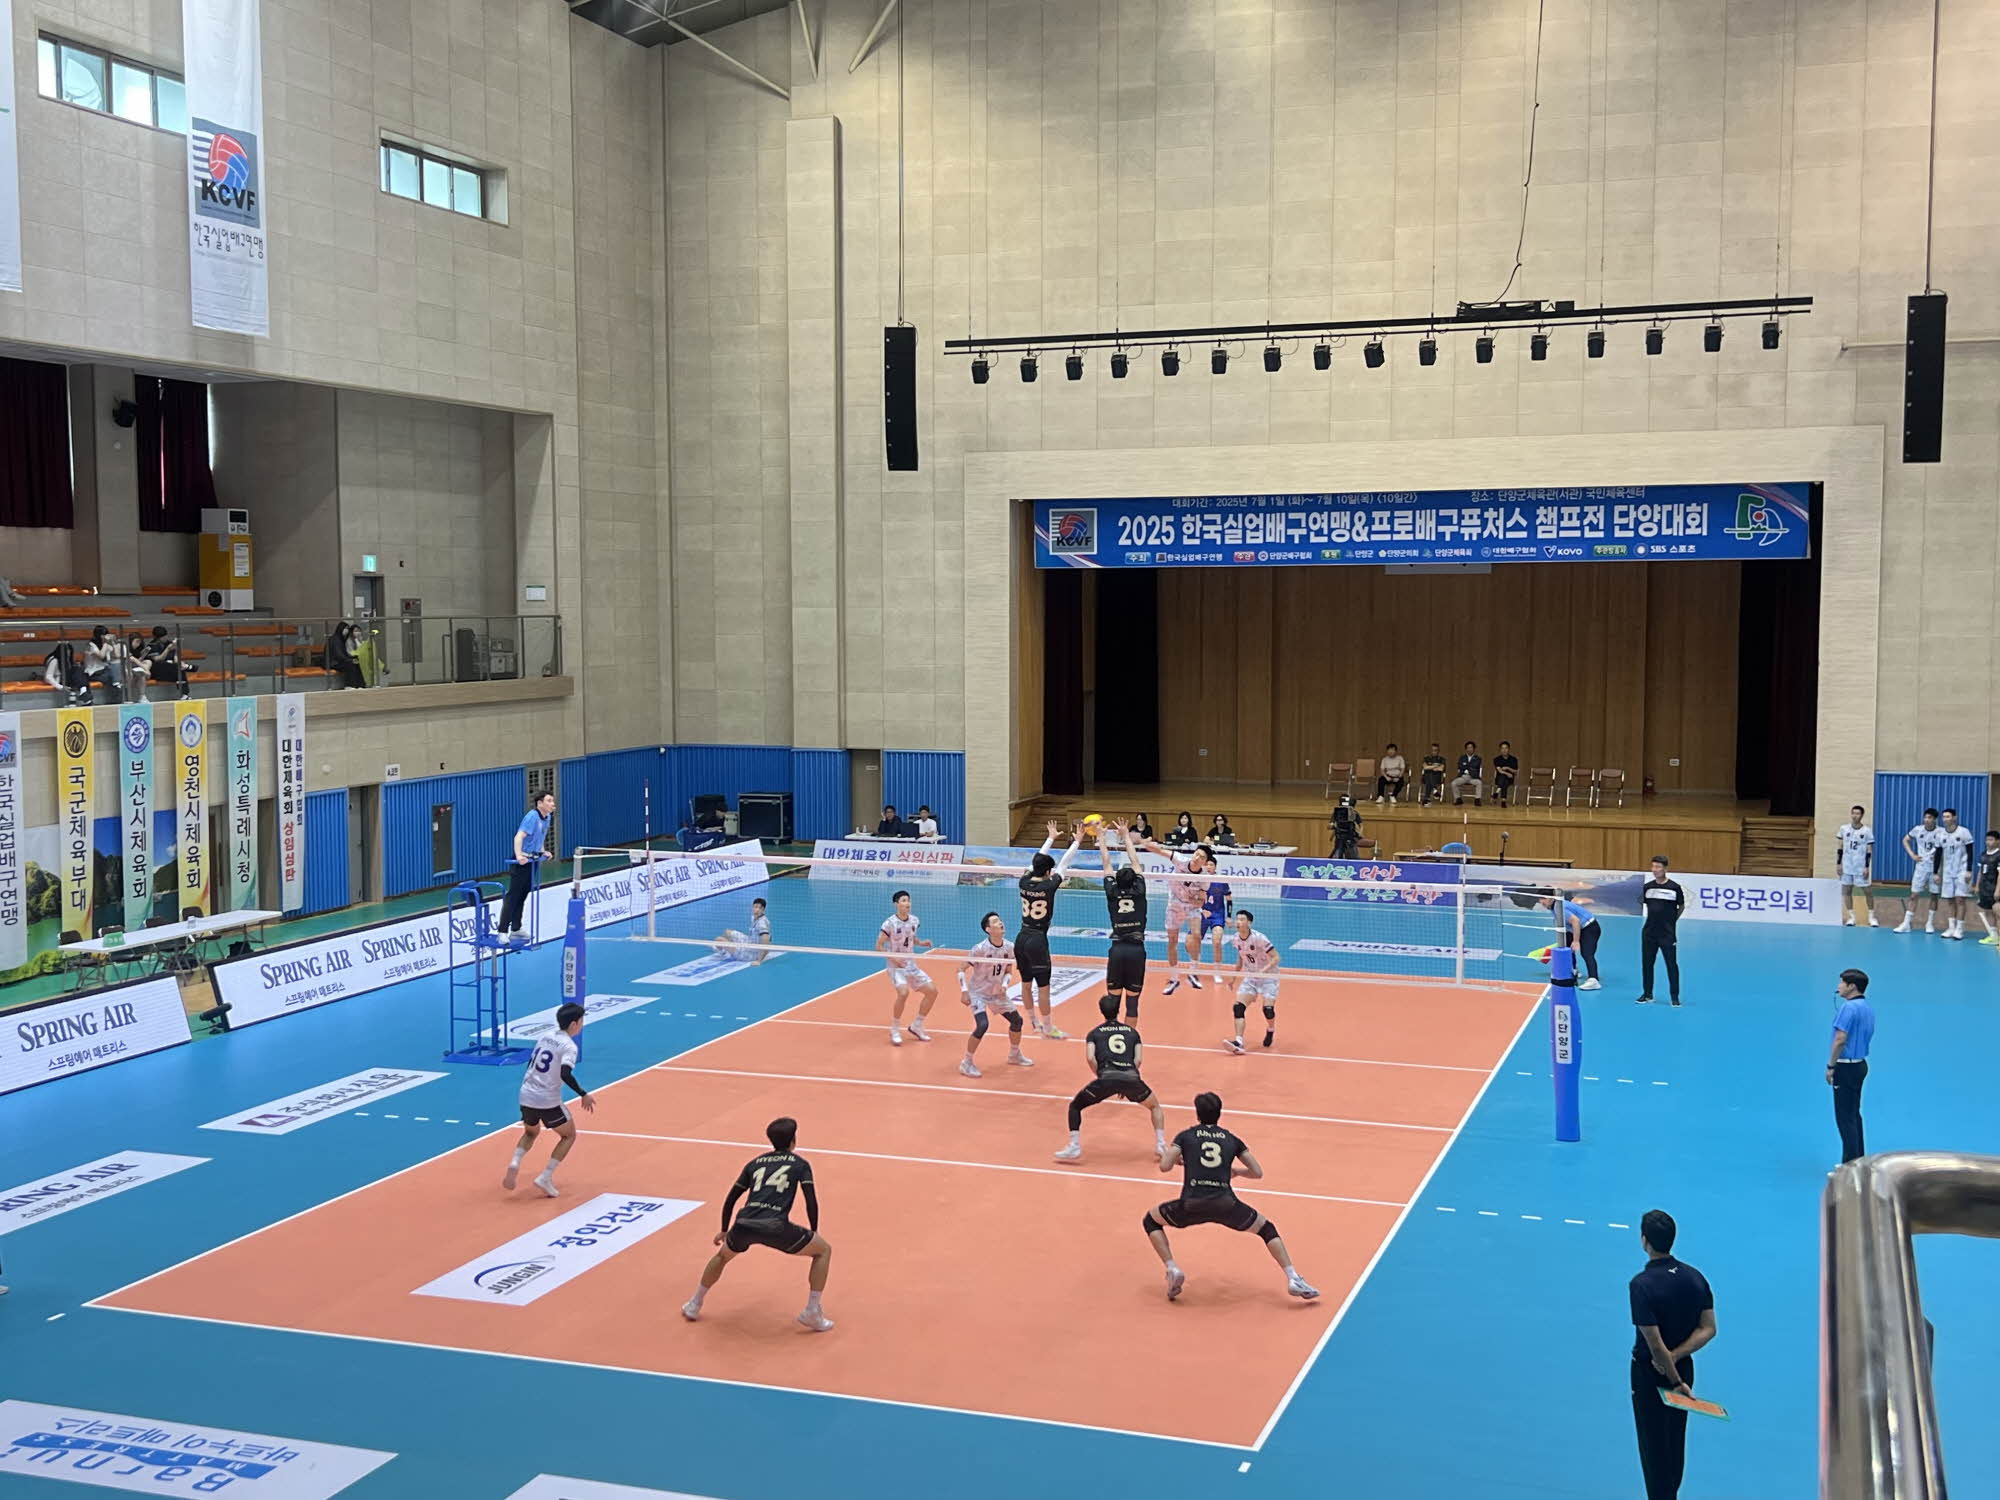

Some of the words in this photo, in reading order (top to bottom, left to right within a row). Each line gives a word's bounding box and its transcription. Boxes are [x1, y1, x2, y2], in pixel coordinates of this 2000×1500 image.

[201, 177, 256, 212] KCVF
[193, 222, 264, 259] 한국실업배구연맹
[1172, 497, 1213, 508] 대회기간:
[1216, 496, 1248, 507] 2025년
[1251, 495, 1266, 507] 7월
[1316, 494, 1332, 505] 7월
[1336, 493, 1374, 505] 10일(목)
[1471, 491, 1494, 502] 장소:
[1118, 515, 1175, 546] 2025
[1181, 507, 1528, 546] 한국실업배구연맹&프로배구퓨처스
[1535, 505, 1605, 539] 챔프전
[1613, 502, 1708, 538] 단양대회
[1056, 536, 1093, 547] KCVF
[1354, 549, 1374, 558] 단양군
[1557, 548, 1583, 556] KOVO
[1650, 545, 1667, 553] SBS
[1669, 545, 1696, 553] 스포츠
[1167, 553, 1223, 562] 한국실업배구연맹
[282, 739, 293, 815] 대한체육회
[129, 760, 147, 899] 부산시체육회
[184, 754, 201, 889] 영천시체육회
[236, 750, 251, 883] 화성특례시청
[68, 766, 88, 912] 국군체육부대
[284, 822, 296, 883] 상임심판
[1849, 840, 1859, 850] 12
[1924, 842, 1934, 851] 13
[822, 847, 892, 862] 대한체육회
[898, 850, 954, 864] 상임심판
[580, 884, 613, 906] PRING
[615, 879, 633, 899] AIR
[637, 869, 674, 893] SPING
[675, 864, 692, 883] AIR
[1700, 887, 1814, 914] 단양군의회
[361, 933, 417, 964] SPRING
[419, 926, 443, 950] AIR
[903, 937, 909, 948] 4
[260, 956, 322, 990] SPRING
[326, 949, 353, 974] AIR
[565, 962, 575, 994] 단양군
[992, 964, 1002, 977] 19
[17, 1011, 99, 1053] SPRING
[104, 1002, 138, 1031] AIR
[1558, 1023, 1569, 1060] 단양군
[1108, 1034, 1127, 1054] 6
[48, 1049, 93, 1071] 스프링에어
[1196, 1130, 1212, 1138] JUN
[1212, 1131, 1226, 1139] HO
[756, 1155, 788, 1164] HYEON
[1200, 1141, 1223, 1168] 3
[74, 1163, 141, 1183] AIR
[753, 1165, 792, 1193] 14
[548, 1201, 664, 1248] 정인건설
[487, 1263, 546, 1295] JUNGIN
[54, 1417, 172, 1445] 매트리스
[34, 1433, 249, 1471] MATTRESS
[173, 1433, 300, 1463] 바르누이
